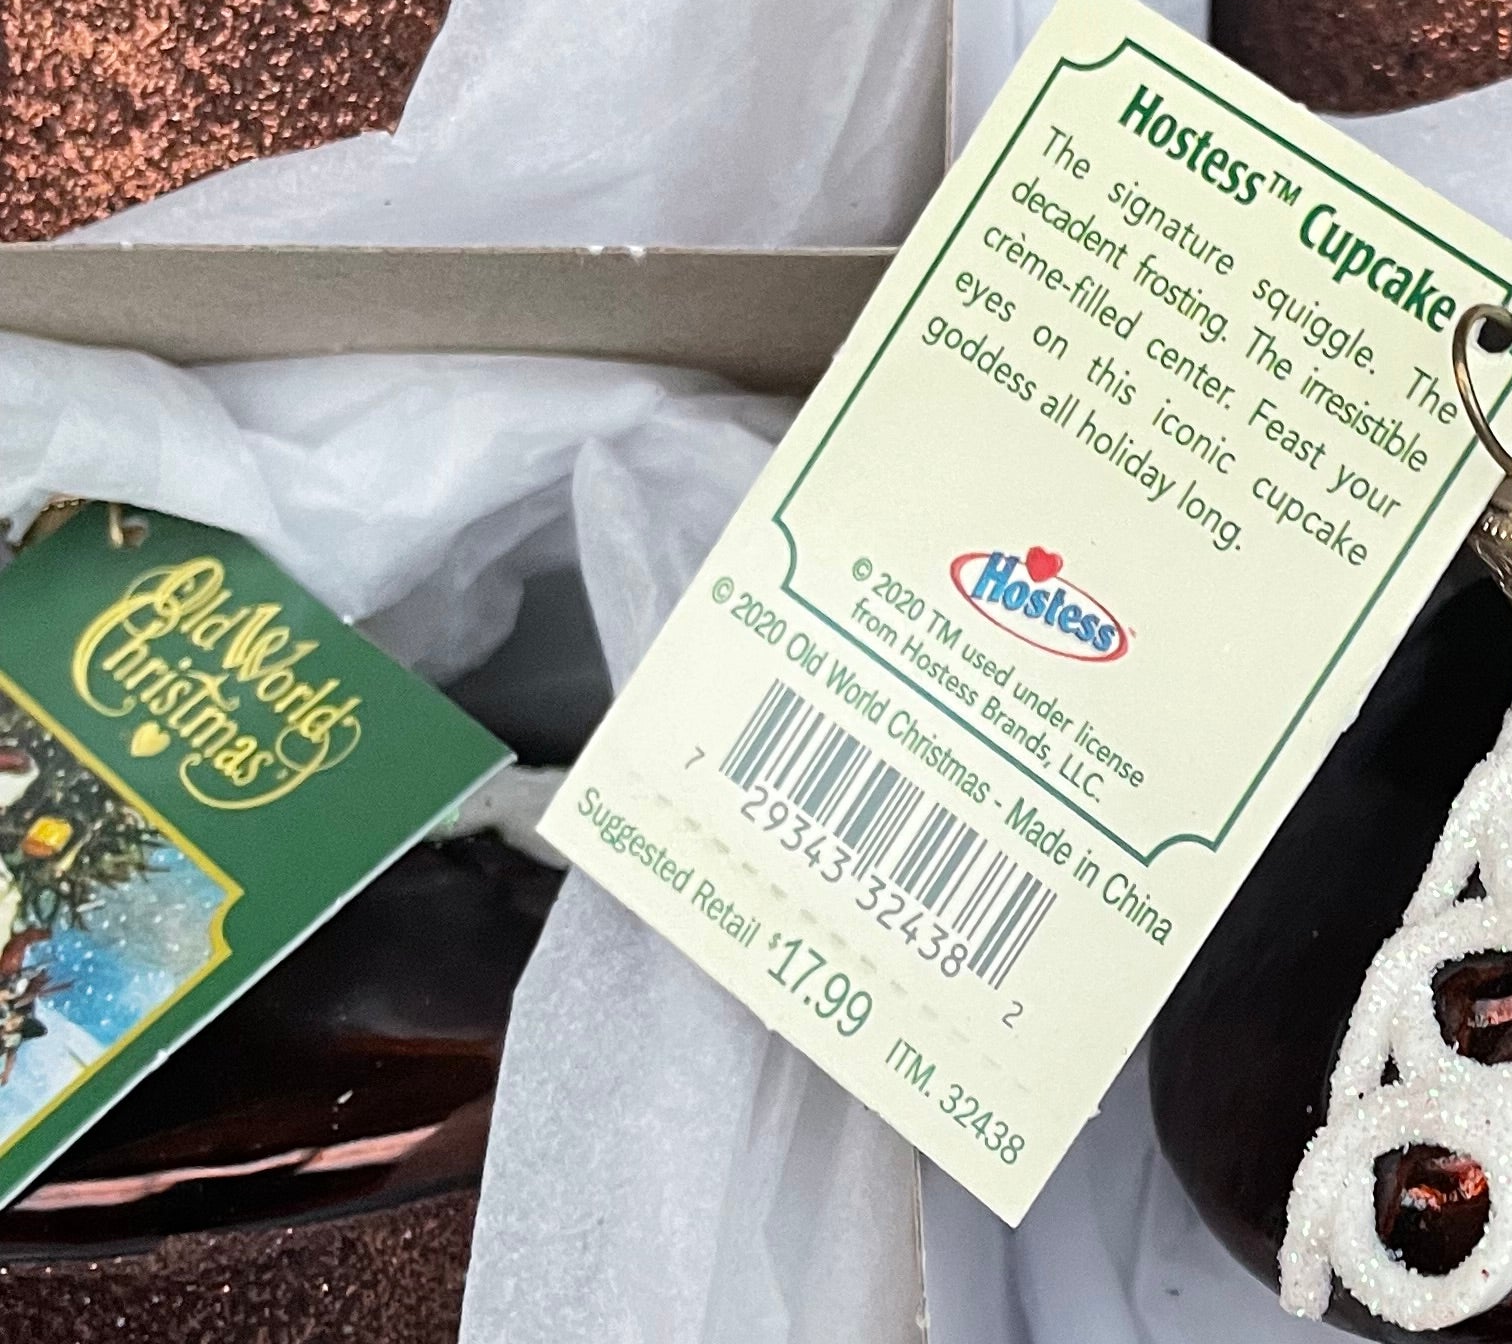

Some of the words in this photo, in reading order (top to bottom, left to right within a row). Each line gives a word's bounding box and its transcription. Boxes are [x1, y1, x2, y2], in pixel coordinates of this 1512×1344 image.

[983, 227, 1142, 339] crème-filled
[1146, 338, 1235, 409] center.
[1248, 398, 1325, 470] Feast
[1326, 464, 1400, 517] your
[1011, 177, 1127, 270] decadent
[1133, 254, 1228, 343] frosting.
[1245, 326, 1292, 380] The
[1300, 367, 1427, 472] irresistible
[1043, 125, 1090, 179] The
[1107, 181, 1233, 275] signature
[1252, 279, 1374, 375] squiggle.
[1406, 366, 1459, 424] The
[1299, 204, 1456, 332] Cupcake
[921, 316, 1036, 401] goddess
[1040, 394, 1079, 427] all
[1076, 409, 1176, 502] holiday
[1177, 480, 1241, 551] long.
[955, 272, 1015, 322] eyes
[1033, 325, 1068, 360] on
[1087, 356, 1136, 405] this
[1152, 398, 1235, 474] iconic
[1252, 478, 1367, 565] cupcake
[71, 590, 276, 787] Christmas
[127, 556, 251, 653] Old
[222, 602, 363, 744] World
[851, 597, 897, 647] from
[900, 635, 978, 706] Hostess
[981, 696, 1050, 768] Brands,
[1059, 754, 1103, 803] LLC.
[871, 573, 925, 620] 2020
[927, 609, 962, 649] TM
[961, 644, 1015, 687] used
[1013, 683, 1073, 732] under
[1074, 721, 1143, 787] license
[971, 550, 1116, 653] Hostess
[730, 592, 786, 645] 2020
[786, 633, 828, 676] Old
[826, 659, 890, 724] World
[887, 710, 990, 803] Christmas
[1004, 797, 1072, 865] Made
[1073, 849, 1099, 888] in
[1102, 873, 1172, 945] China
[578, 788, 694, 893] Suggested
[691, 879, 761, 947] Retail
[885, 1038, 935, 1097] ITM.
[939, 1084, 1024, 1164] 32438
[740, 786, 851, 882] 29343
[855, 875, 968, 977] 32438
